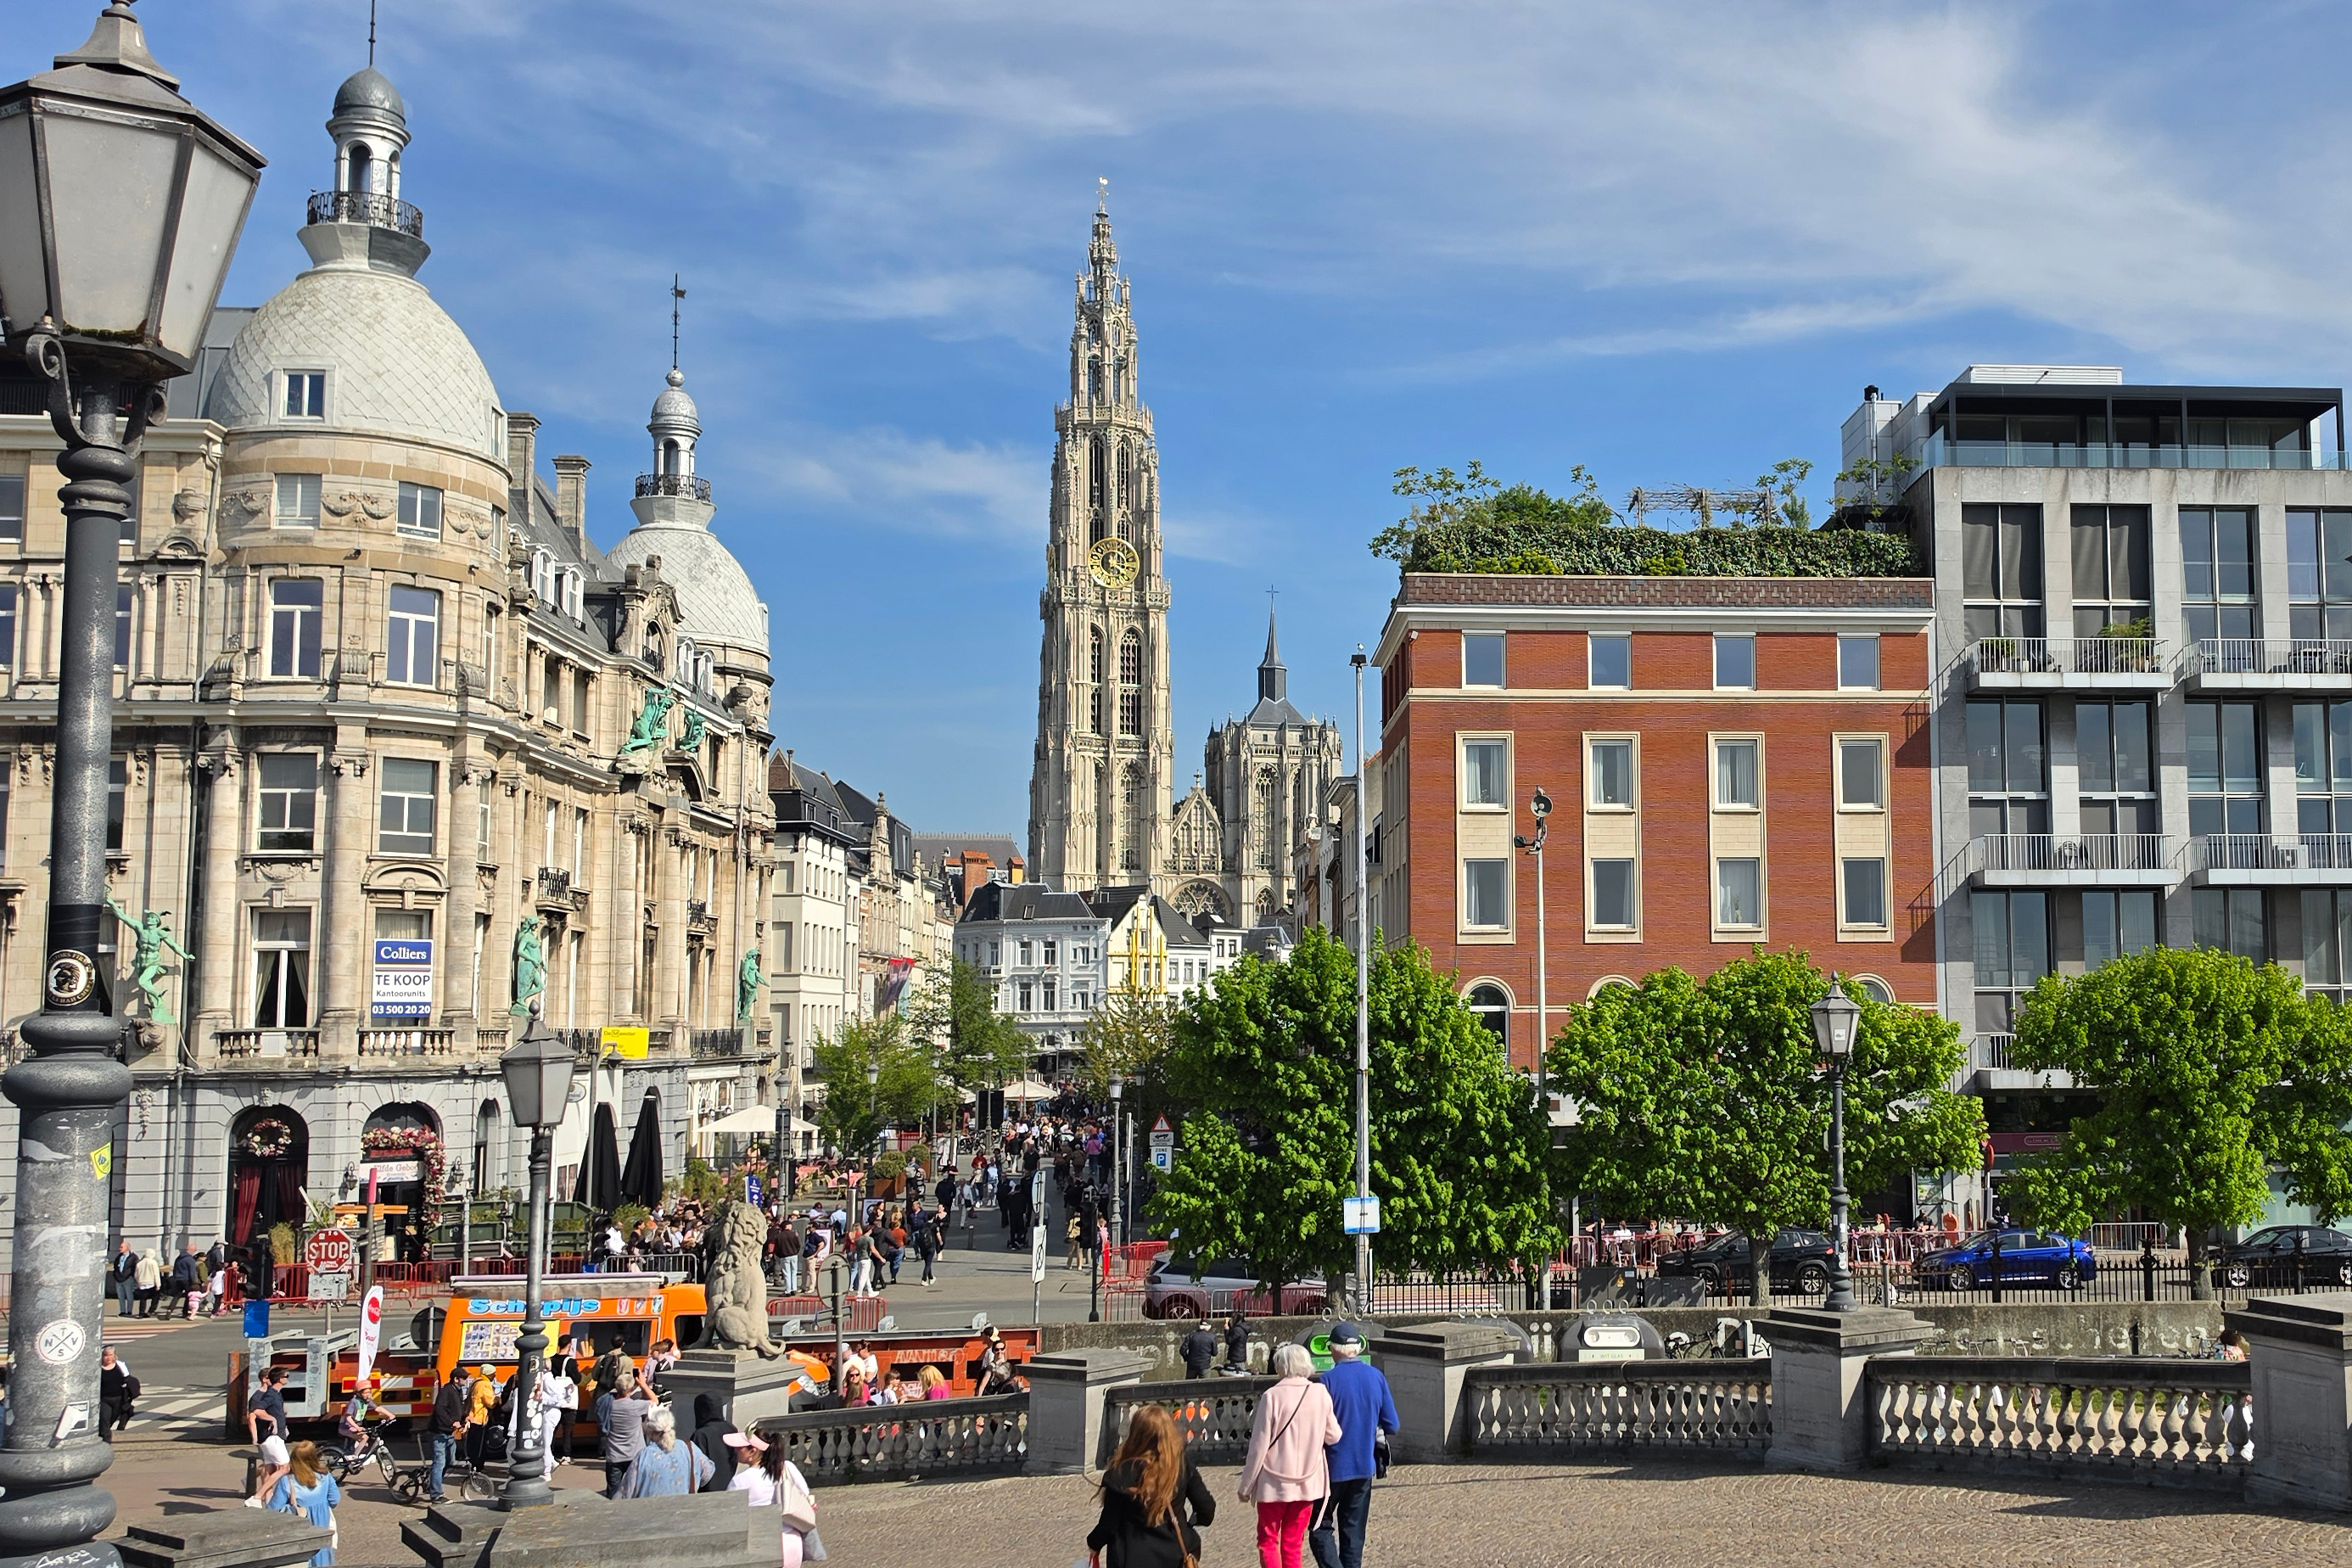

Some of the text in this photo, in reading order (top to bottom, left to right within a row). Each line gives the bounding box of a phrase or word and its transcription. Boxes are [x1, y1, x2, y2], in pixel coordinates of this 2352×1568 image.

[380, 946, 427, 960] Colliers
[375, 974, 430, 986] TE KOOP
[372, 1005, 431, 1015] 03 500 20 20
[309, 1240, 350, 1260] STOP
[469, 1298, 601, 1317] Schpijs
